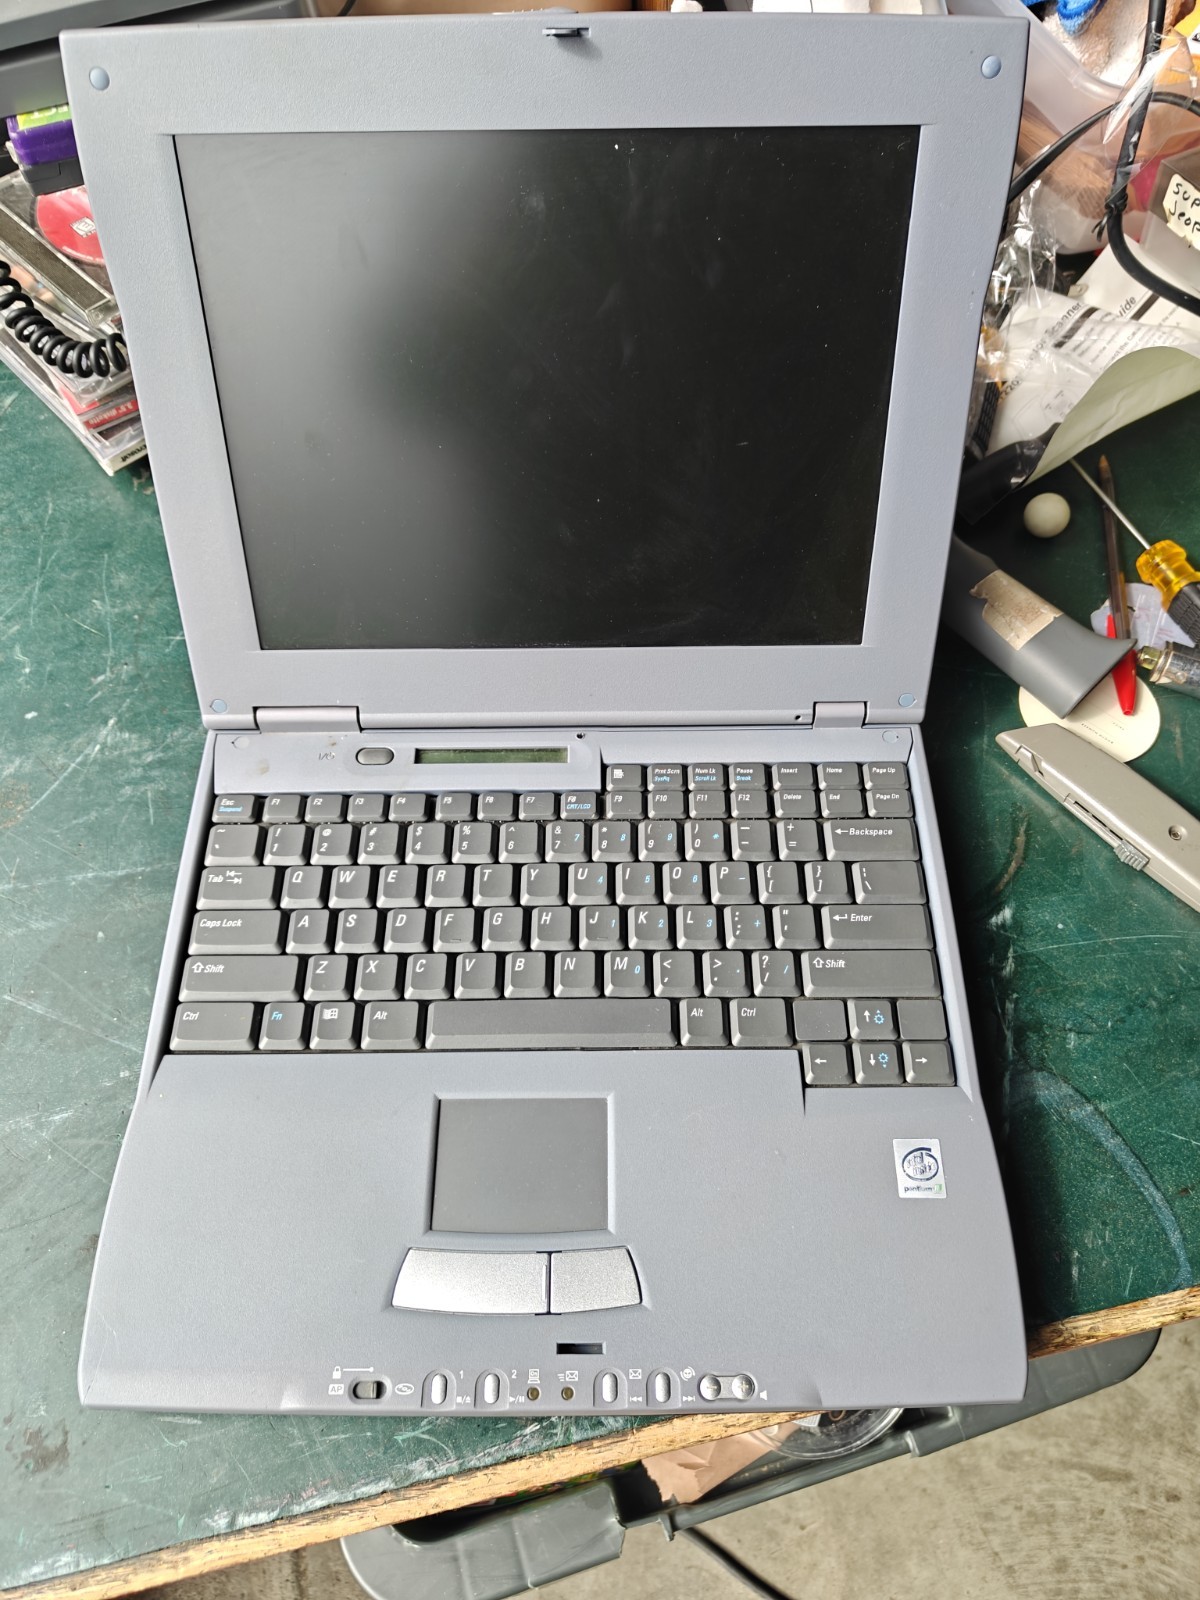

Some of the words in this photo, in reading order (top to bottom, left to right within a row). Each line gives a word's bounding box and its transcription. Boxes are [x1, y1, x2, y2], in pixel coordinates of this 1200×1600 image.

[121, 444, 147, 462] crosoft
[875, 793, 890, 801] Page
[667, 833, 673, 841] 9
[849, 828, 893, 837] Backspace
[620, 834, 627, 842] 8
[272, 843, 278, 852] 1
[320, 843, 328, 851] 2
[367, 842, 374, 851] 3
[414, 842, 421, 850] 4
[461, 841, 468, 850] 5
[508, 841, 514, 850] 6
[554, 840, 561, 849] 7
[601, 840, 608, 849] 8
[647, 839, 654, 848] 9
[694, 839, 701, 848] 0
[292, 871, 304, 883] Q
[339, 871, 355, 883] W
[387, 870, 398, 882] E
[436, 870, 446, 882] R
[483, 869, 492, 881] T
[530, 869, 539, 881] Y
[577, 868, 588, 880] U
[625, 868, 631, 880] I
[672, 867, 682, 879] O
[720, 867, 729, 880] P
[208, 875, 224, 883] Tab
[597, 876, 604, 884] 4
[644, 875, 651, 883] 5
[692, 875, 698, 883] 6
[298, 915, 309, 928] A
[346, 914, 357, 927] S
[395, 914, 407, 927] D
[444, 914, 454, 926] F
[492, 912, 503, 925] G
[540, 912, 552, 925] H
[589, 911, 599, 924] J
[638, 911, 649, 924] K
[686, 911, 694, 924] L
[850, 914, 873, 922] Enter
[200, 919, 221, 928] Caps
[222, 919, 243, 927] Lock
[611, 919, 615, 927] 1
[658, 919, 664, 928] 2
[706, 919, 713, 928] 3
[315, 961, 329, 974] Z
[365, 960, 379, 973] X
[415, 959, 427, 973] C
[465, 959, 476, 972] V
[514, 958, 525, 971] B
[564, 957, 576, 970] N
[614, 957, 628, 970] M
[825, 959, 845, 968] Shift
[204, 964, 225, 973] Shift
[182, 1011, 199, 1021] Ctrl
[271, 1012, 283, 1020] Fn
[373, 1011, 388, 1019] Alt
[690, 1008, 703, 1017] Alt
[741, 1008, 756, 1017] Ctrl
[459, 1370, 464, 1379] 1
[511, 1370, 517, 1379] 2
[330, 1386, 343, 1394] AP
